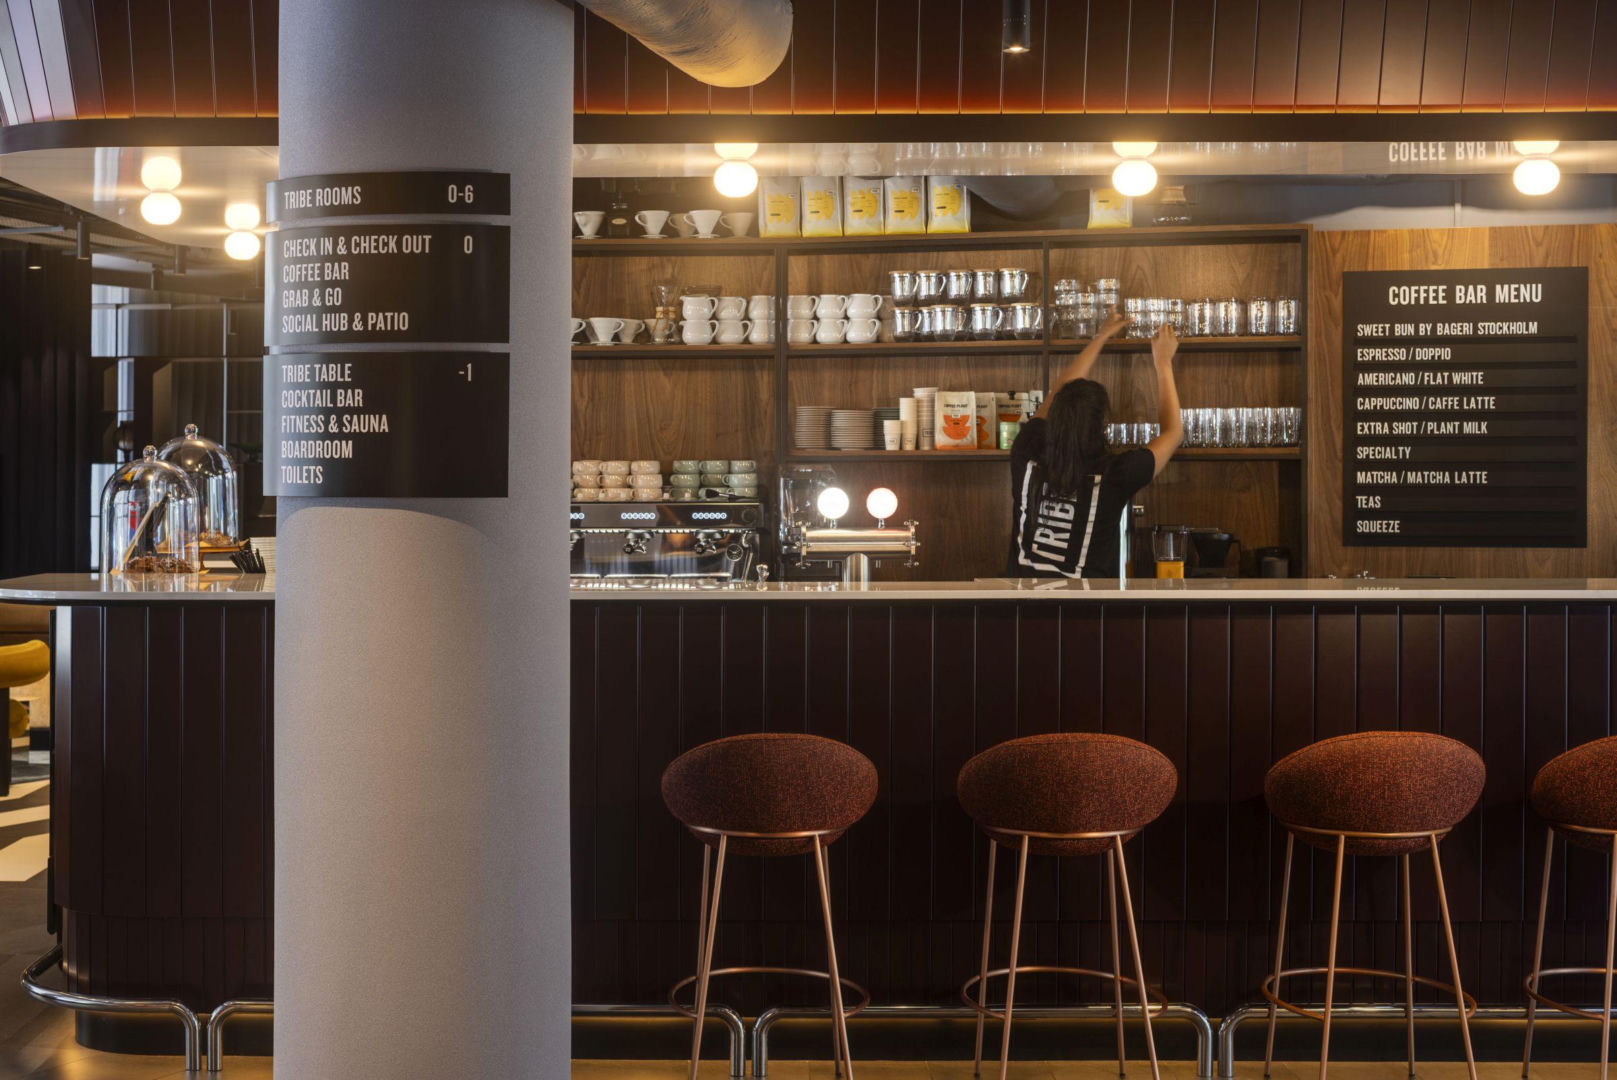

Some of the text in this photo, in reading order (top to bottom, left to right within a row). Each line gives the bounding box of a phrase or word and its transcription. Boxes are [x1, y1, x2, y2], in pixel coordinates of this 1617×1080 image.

[285, 185, 474, 209] TRIBE ROOMS 0-6
[284, 235, 473, 257] CHECK IN & CHECK OUT 0
[283, 262, 349, 283] COFFEE BAR
[283, 288, 341, 308] GRAB & GO
[1389, 284, 1542, 305] COFFEE BAR MENU
[282, 312, 409, 333] SOCIAL HUB & PATIO
[1357, 322, 1537, 336] SWEET BUN BY BAGERI STOCKHOLM
[1358, 349, 1406, 361] ESPRESSO
[1416, 348, 1451, 360] DOPPIO
[282, 363, 472, 382] TRIBE TABLE -1
[1358, 373, 1415, 385] AMERICANO
[1424, 372, 1449, 385] FLAT
[1452, 372, 1484, 384] WHITE
[282, 389, 363, 408] COCKTAIL BAR
[1357, 397, 1419, 410] CAPPUCCINO
[1429, 397, 1459, 409] CAFFE
[1464, 397, 1495, 409] LATTE
[282, 414, 389, 433] FITNESS & SAUNA
[1357, 422, 1389, 435] EXTRA
[1392, 422, 1418, 434] SHOT
[1428, 422, 1460, 434] PLANT
[1463, 422, 1488, 434] MILK
[281, 440, 352, 458] BOARDROOM
[1357, 447, 1411, 459] SPECIALTY
[281, 466, 323, 484] TOILETS
[1357, 472, 1397, 484] MATCHA
[1408, 472, 1450, 484] MATCHA
[1455, 472, 1488, 483] LATTE
[1356, 496, 1381, 508] TEAS
[1357, 520, 1400, 533] SQUEEZE
